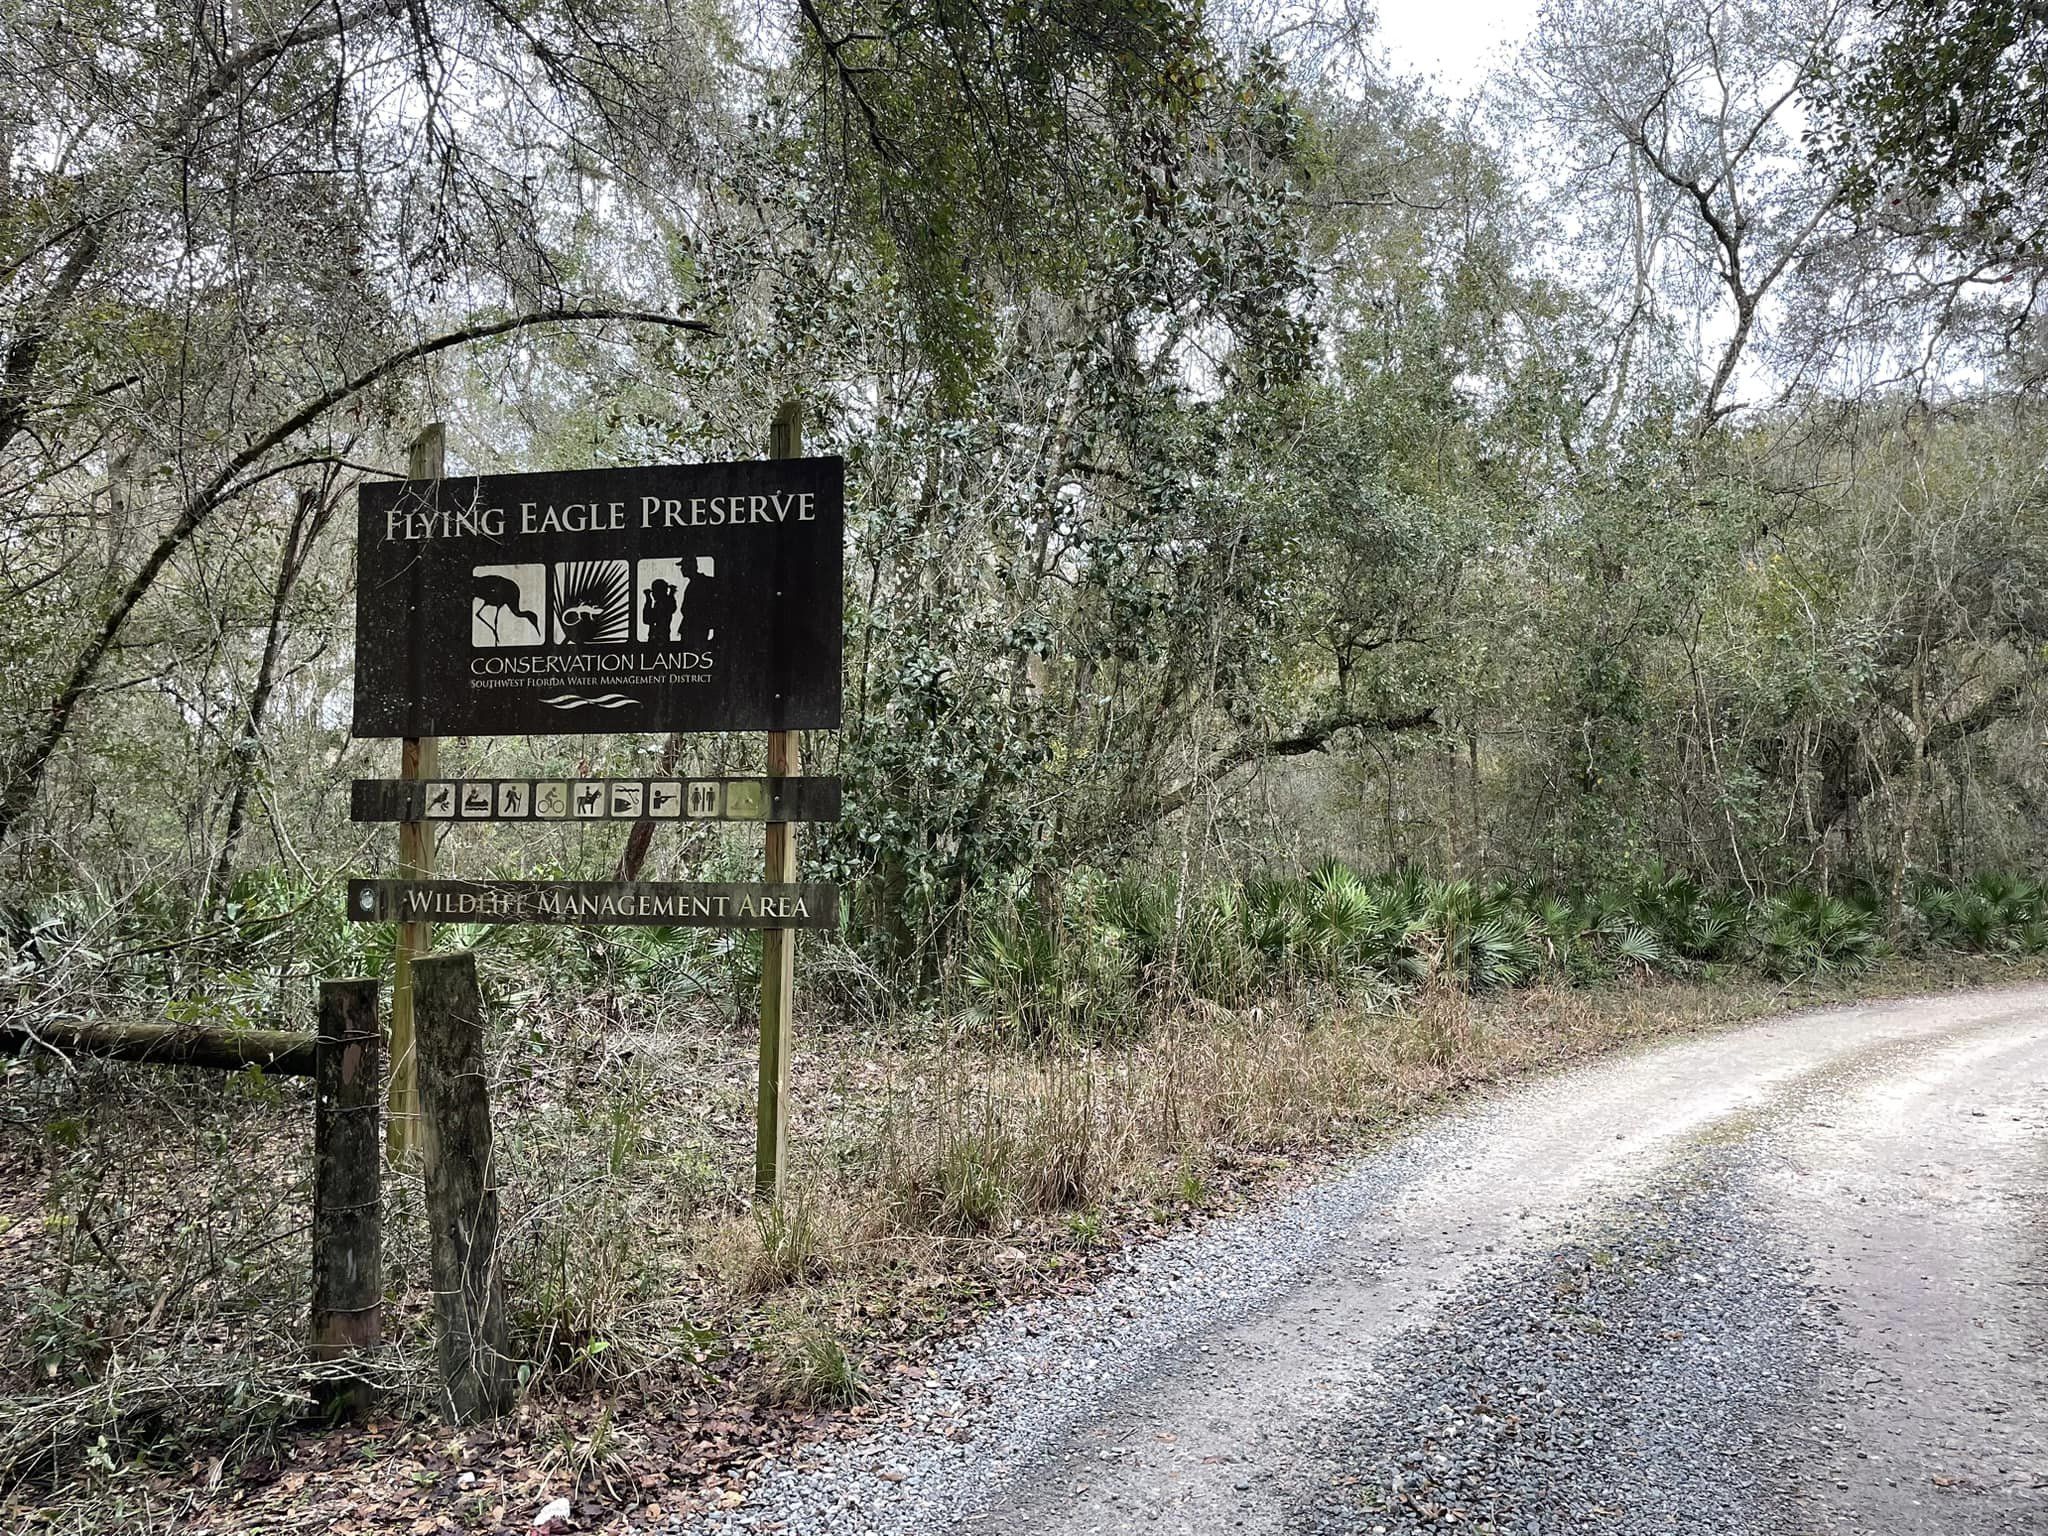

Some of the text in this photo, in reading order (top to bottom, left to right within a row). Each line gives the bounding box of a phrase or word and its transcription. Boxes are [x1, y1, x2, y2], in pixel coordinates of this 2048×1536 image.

[384, 492, 816, 541] FLYING EAGLE PRESERVE
[471, 651, 714, 675] CONSERVATION LANDS
[471, 673, 713, 689] SOUTHWEST FLORIDA WATER MANAGEMENT DISTRICT
[408, 889, 810, 918] WILDLIFE MANAGEMENT AREA
